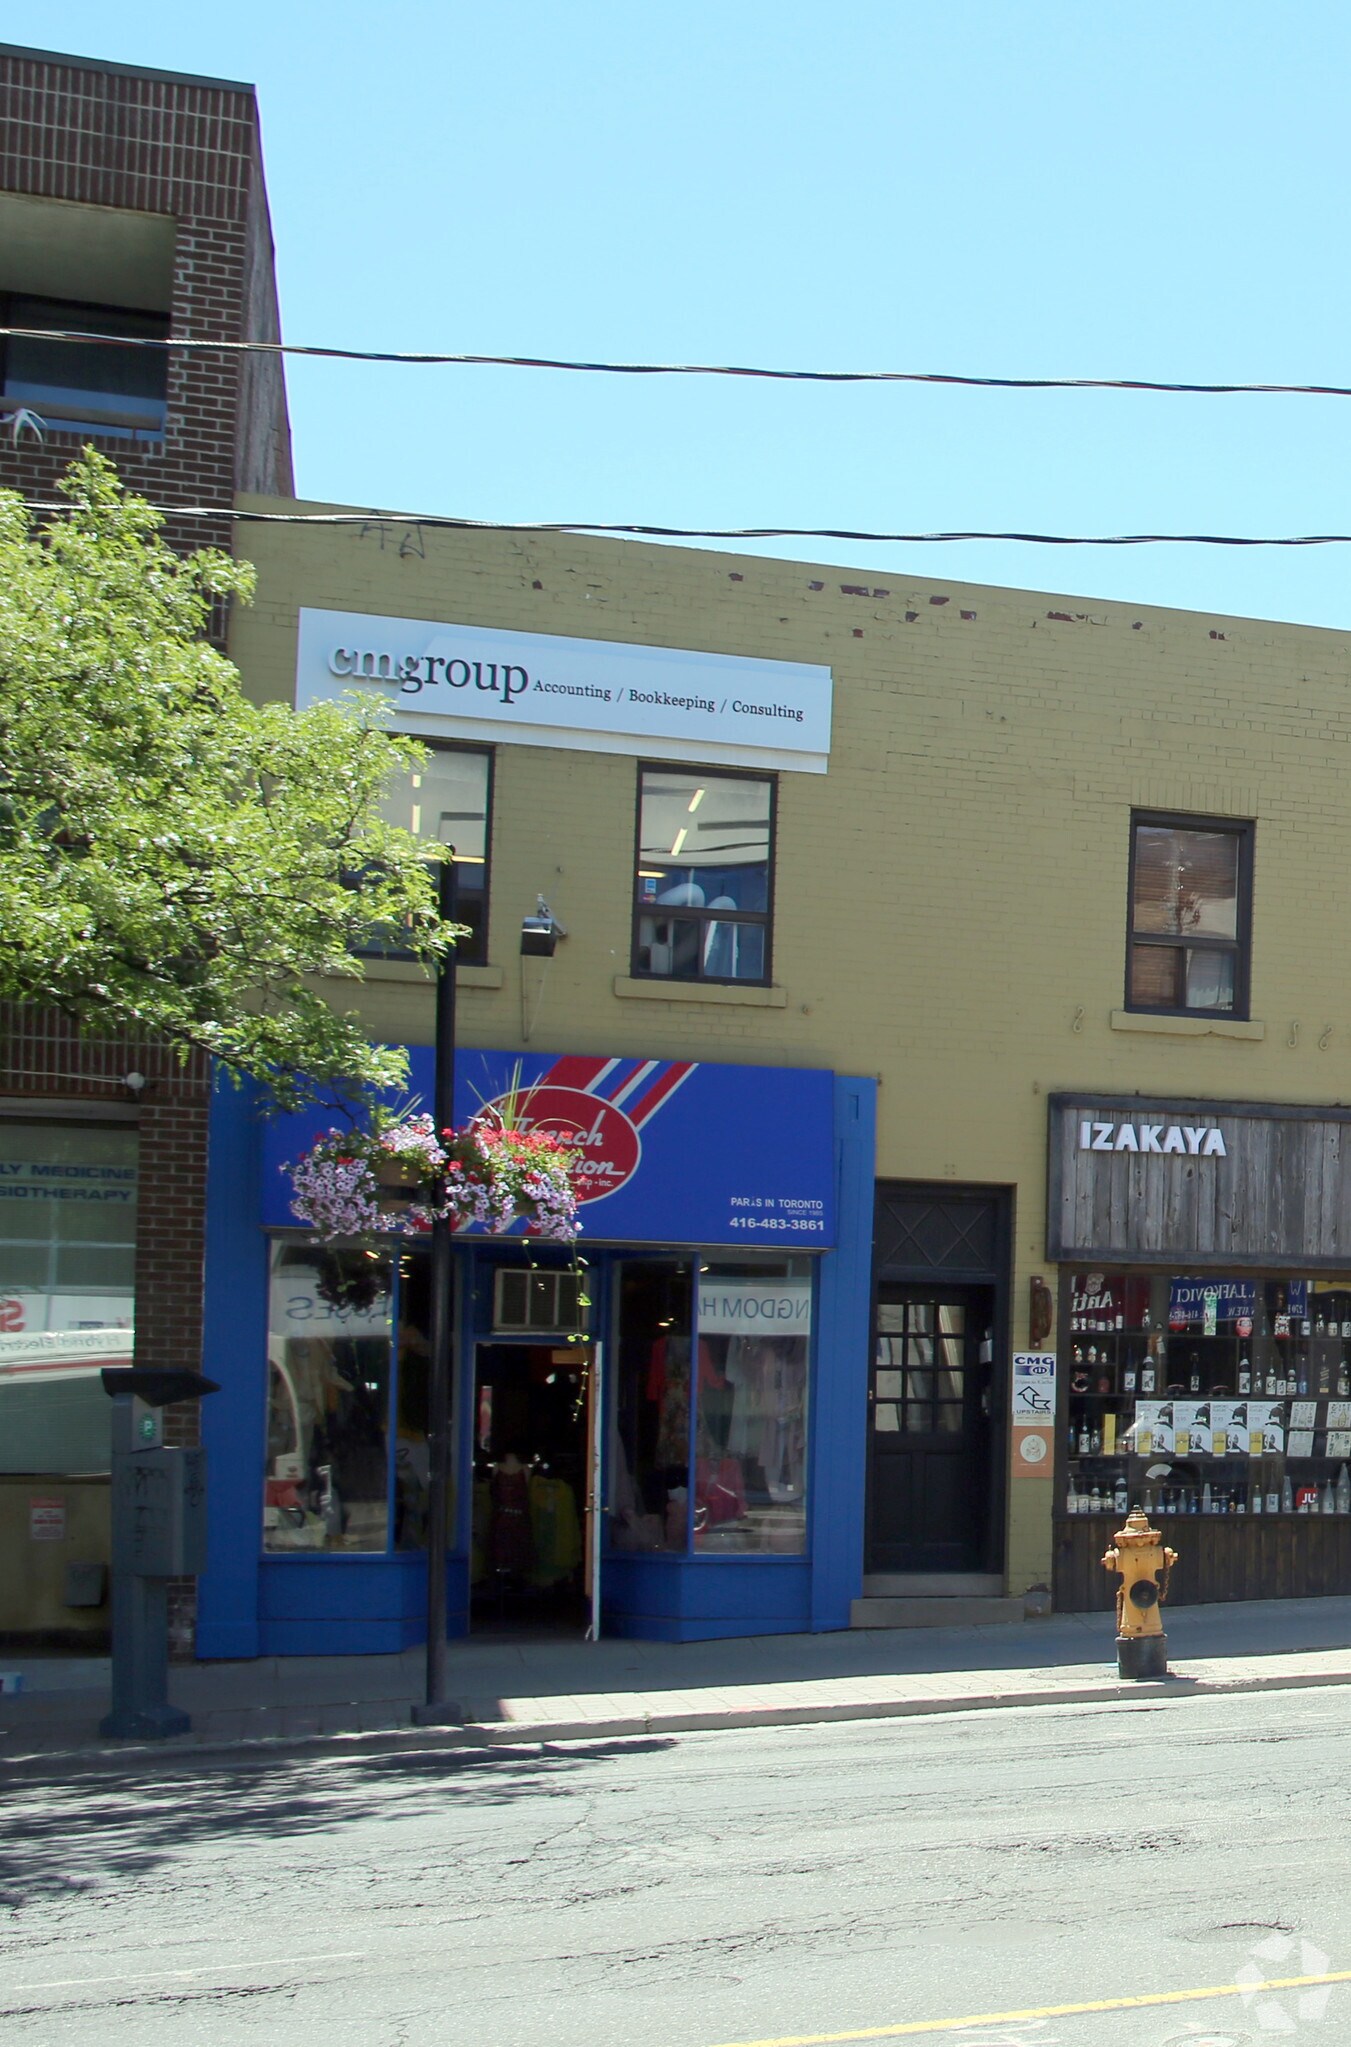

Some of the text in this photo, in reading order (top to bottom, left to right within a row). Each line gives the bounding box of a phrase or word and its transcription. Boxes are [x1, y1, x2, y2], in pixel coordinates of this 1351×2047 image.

[328, 647, 529, 704] cmgroup
[532, 680, 612, 702] Accounting
[629, 689, 716, 712] Bookkeeping
[732, 700, 804, 722] Consulting
[1080, 1121, 1227, 1157] IZAKAYA
[31, 1165, 136, 1180] MEDICINE
[765, 1198, 775, 1208] IN
[778, 1199, 824, 1210] TORONTO
[730, 1217, 824, 1231] 416-483-3861
